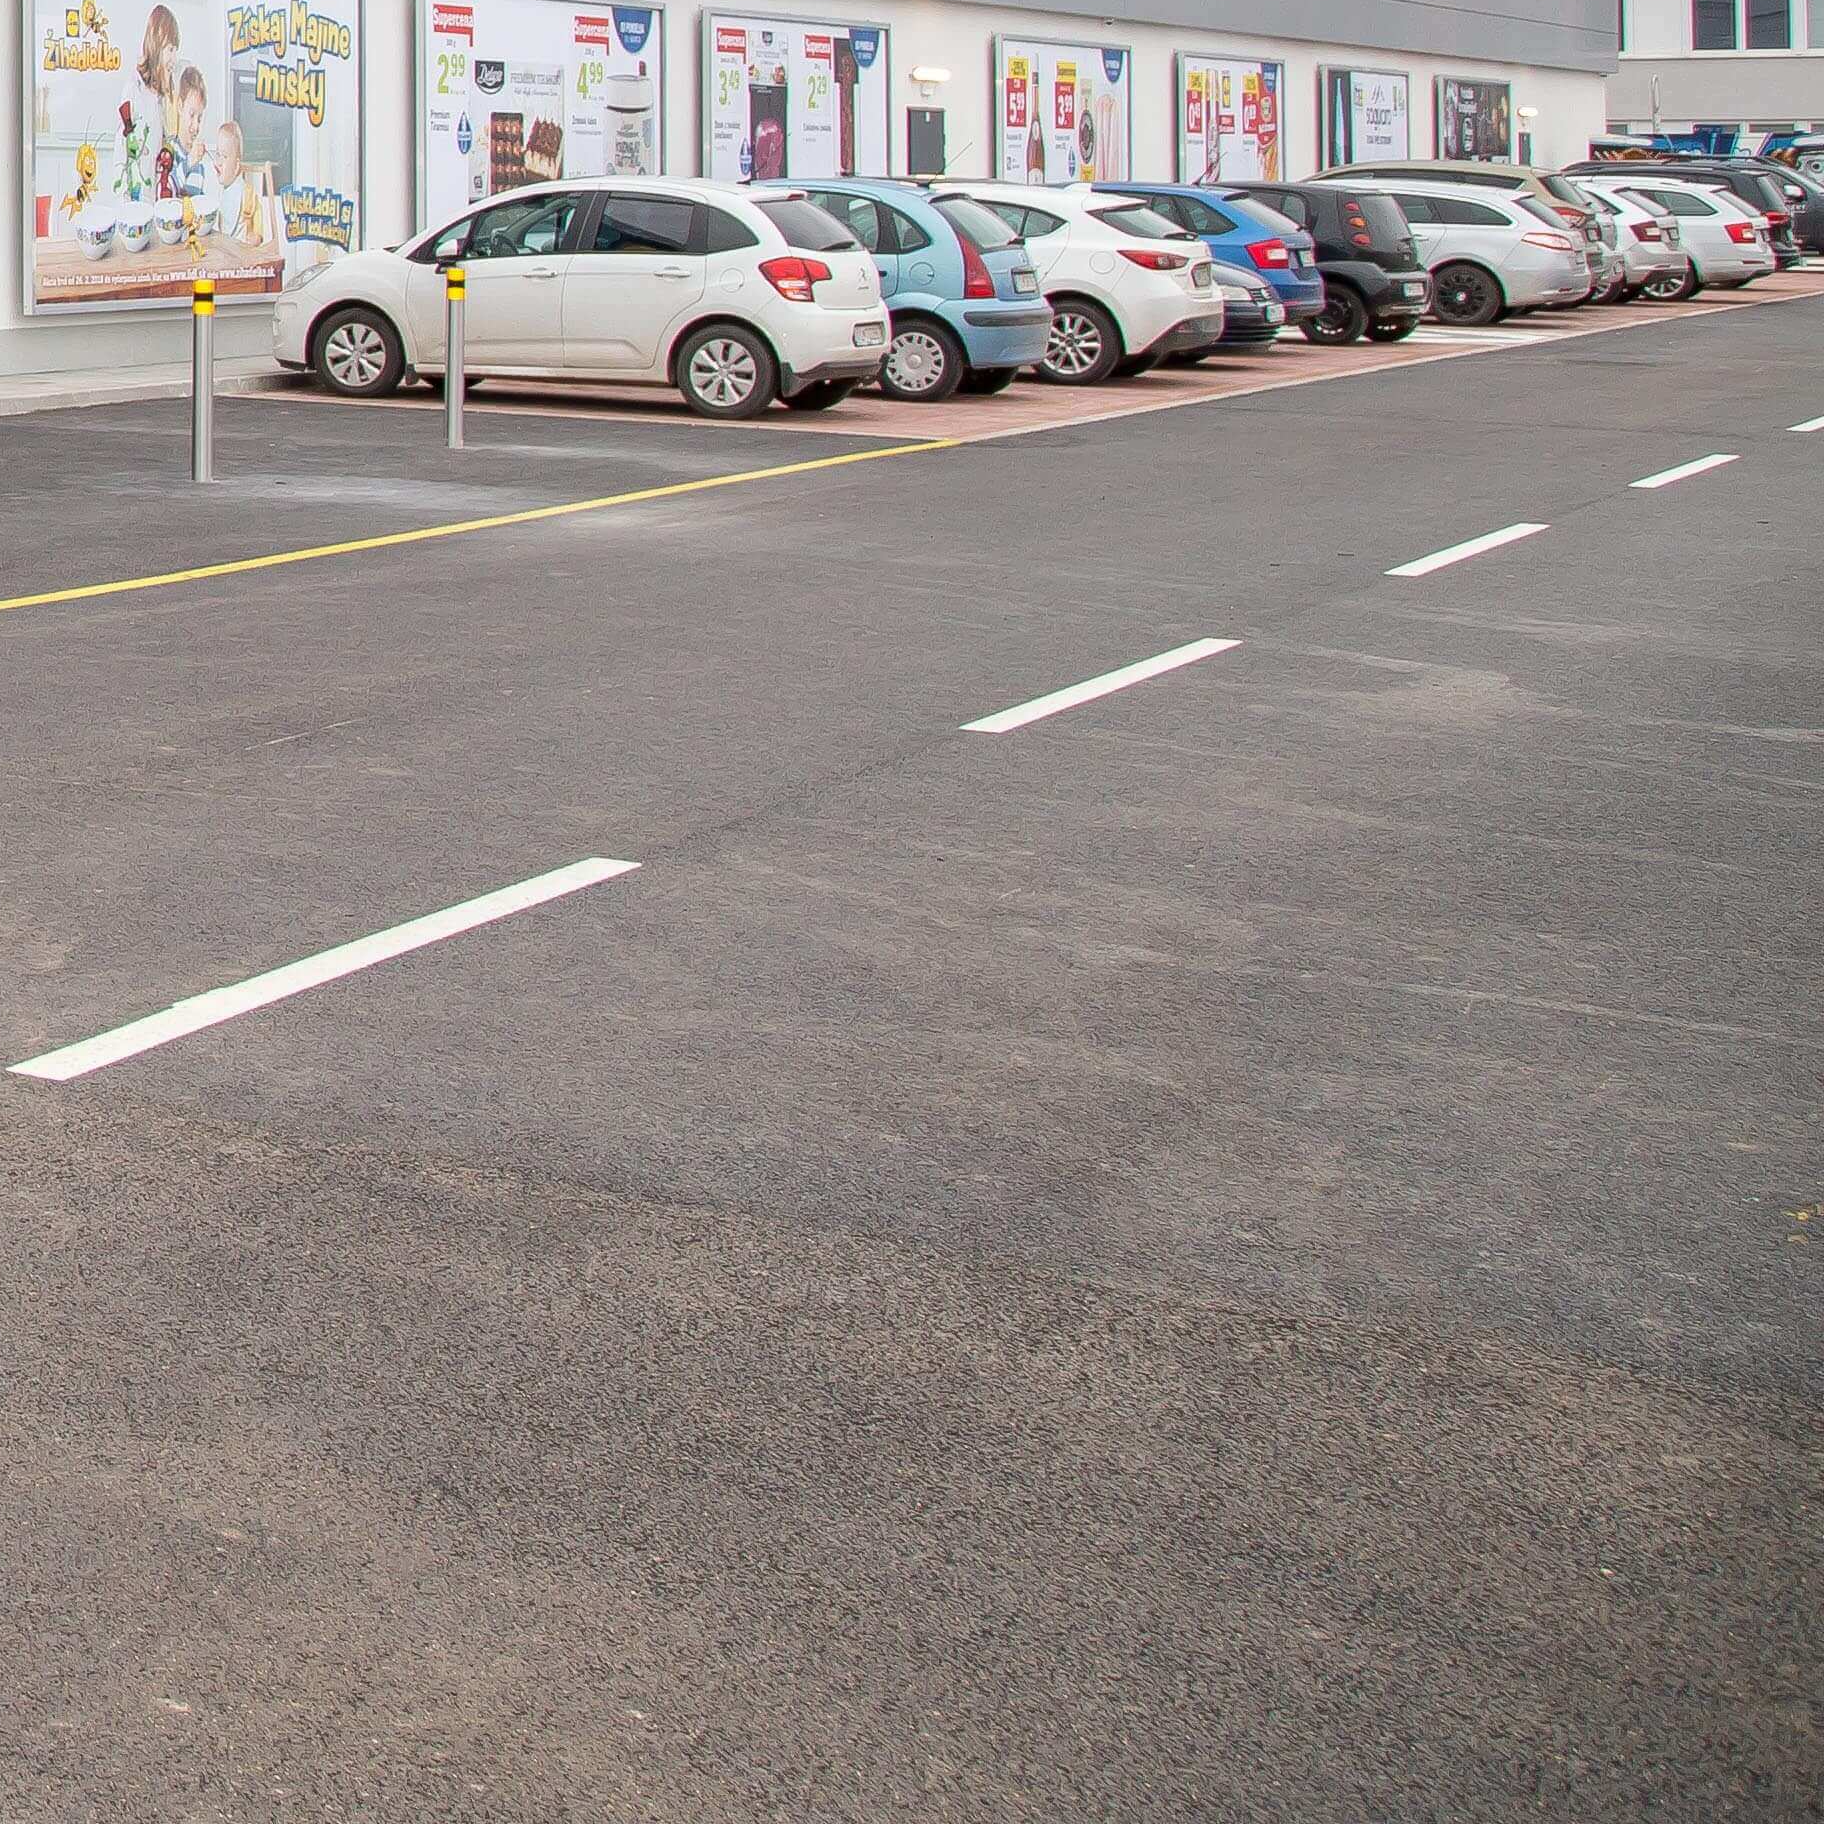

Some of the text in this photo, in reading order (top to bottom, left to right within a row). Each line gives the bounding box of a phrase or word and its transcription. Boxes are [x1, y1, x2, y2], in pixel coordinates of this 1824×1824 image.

[227, 3, 287, 59] Získaj
[432, 7, 474, 29] Supercena
[255, 58, 325, 127] misky
